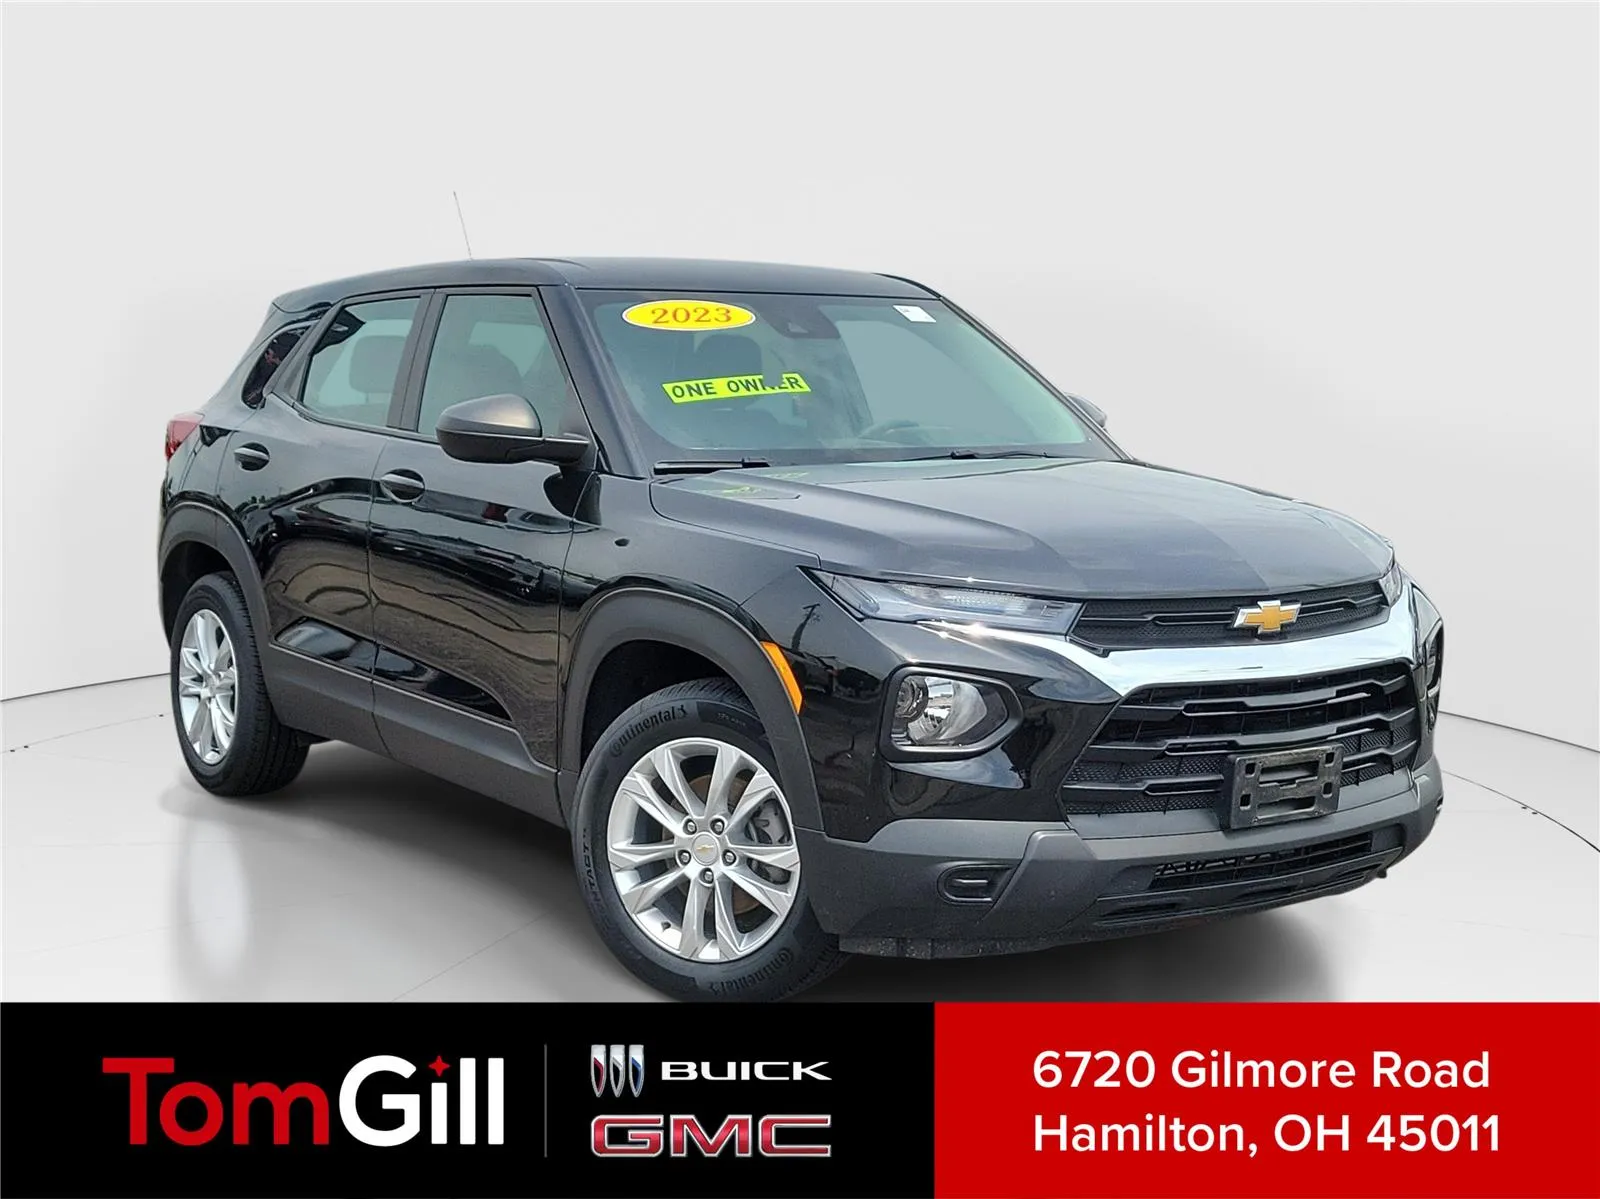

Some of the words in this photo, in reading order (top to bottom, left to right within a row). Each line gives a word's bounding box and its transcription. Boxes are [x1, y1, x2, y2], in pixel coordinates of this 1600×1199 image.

[651, 307, 732, 324] 2023
[671, 382, 717, 399] ONE
[726, 376, 804, 393] OWR
[610, 705, 676, 757] Continental
